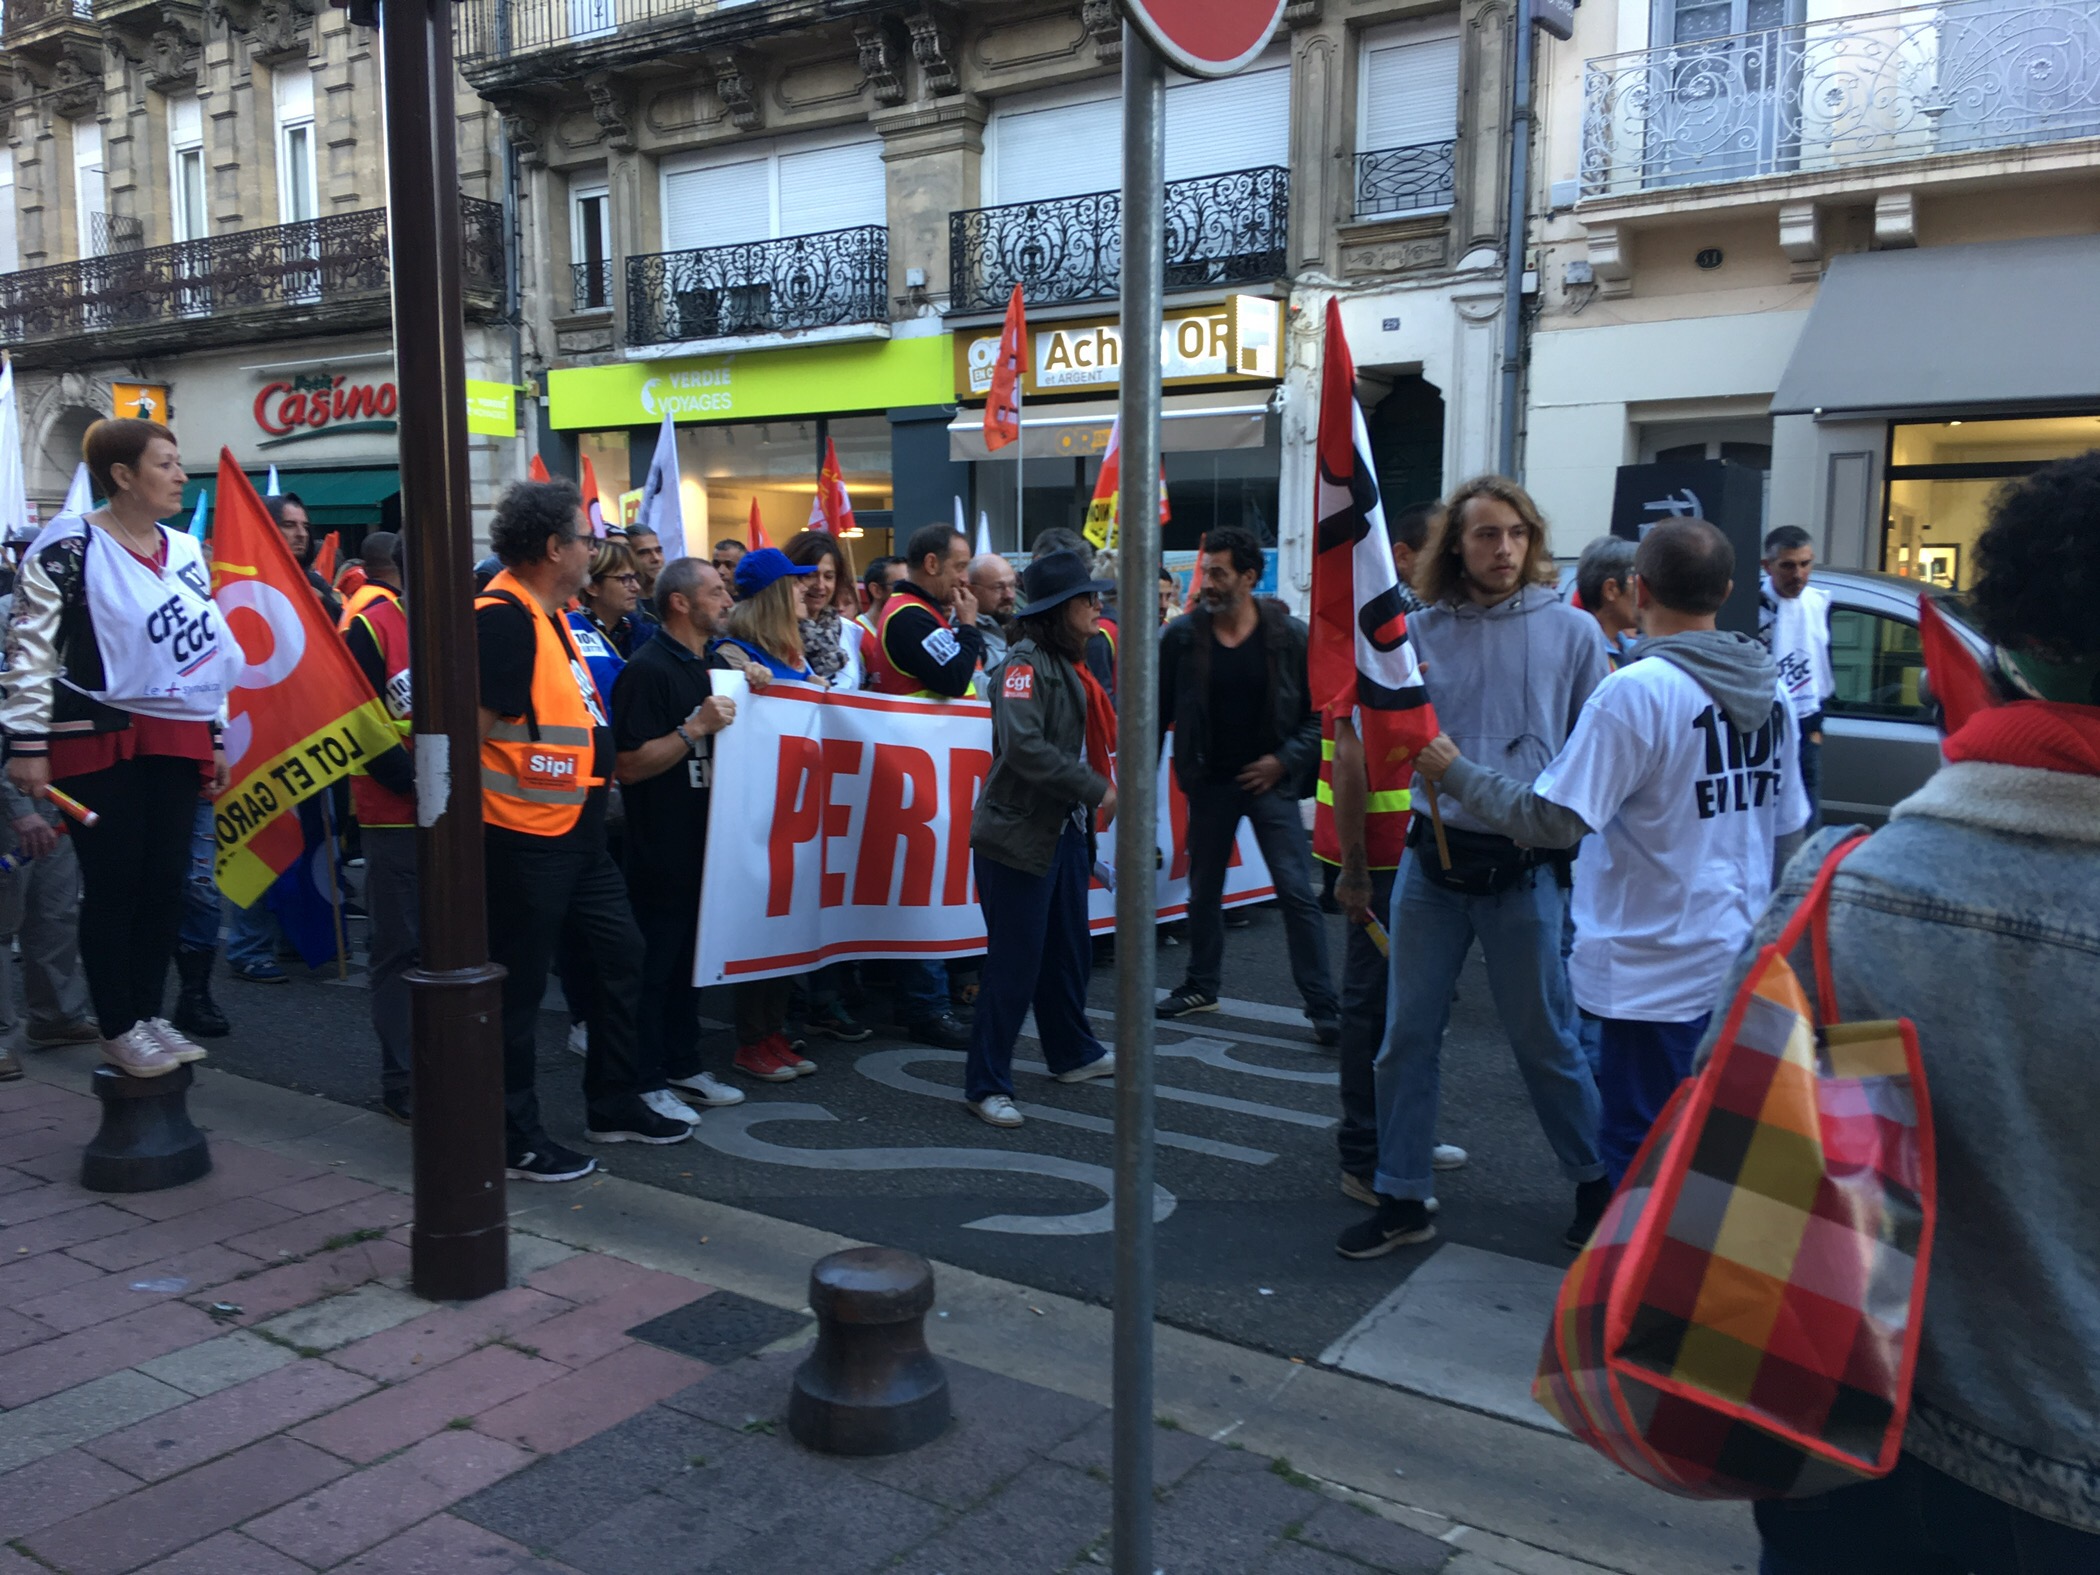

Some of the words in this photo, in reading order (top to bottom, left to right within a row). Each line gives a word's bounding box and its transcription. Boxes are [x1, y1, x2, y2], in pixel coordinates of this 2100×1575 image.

[1058, 370, 1103, 385] ARGENT
[253, 374, 397, 436] Casino
[657, 391, 733, 414] VOYAGES
[146, 594, 188, 644] CFE
[172, 610, 215, 662] CGC
[1005, 674, 1032, 692] cgt
[529, 754, 575, 778] Sipi
